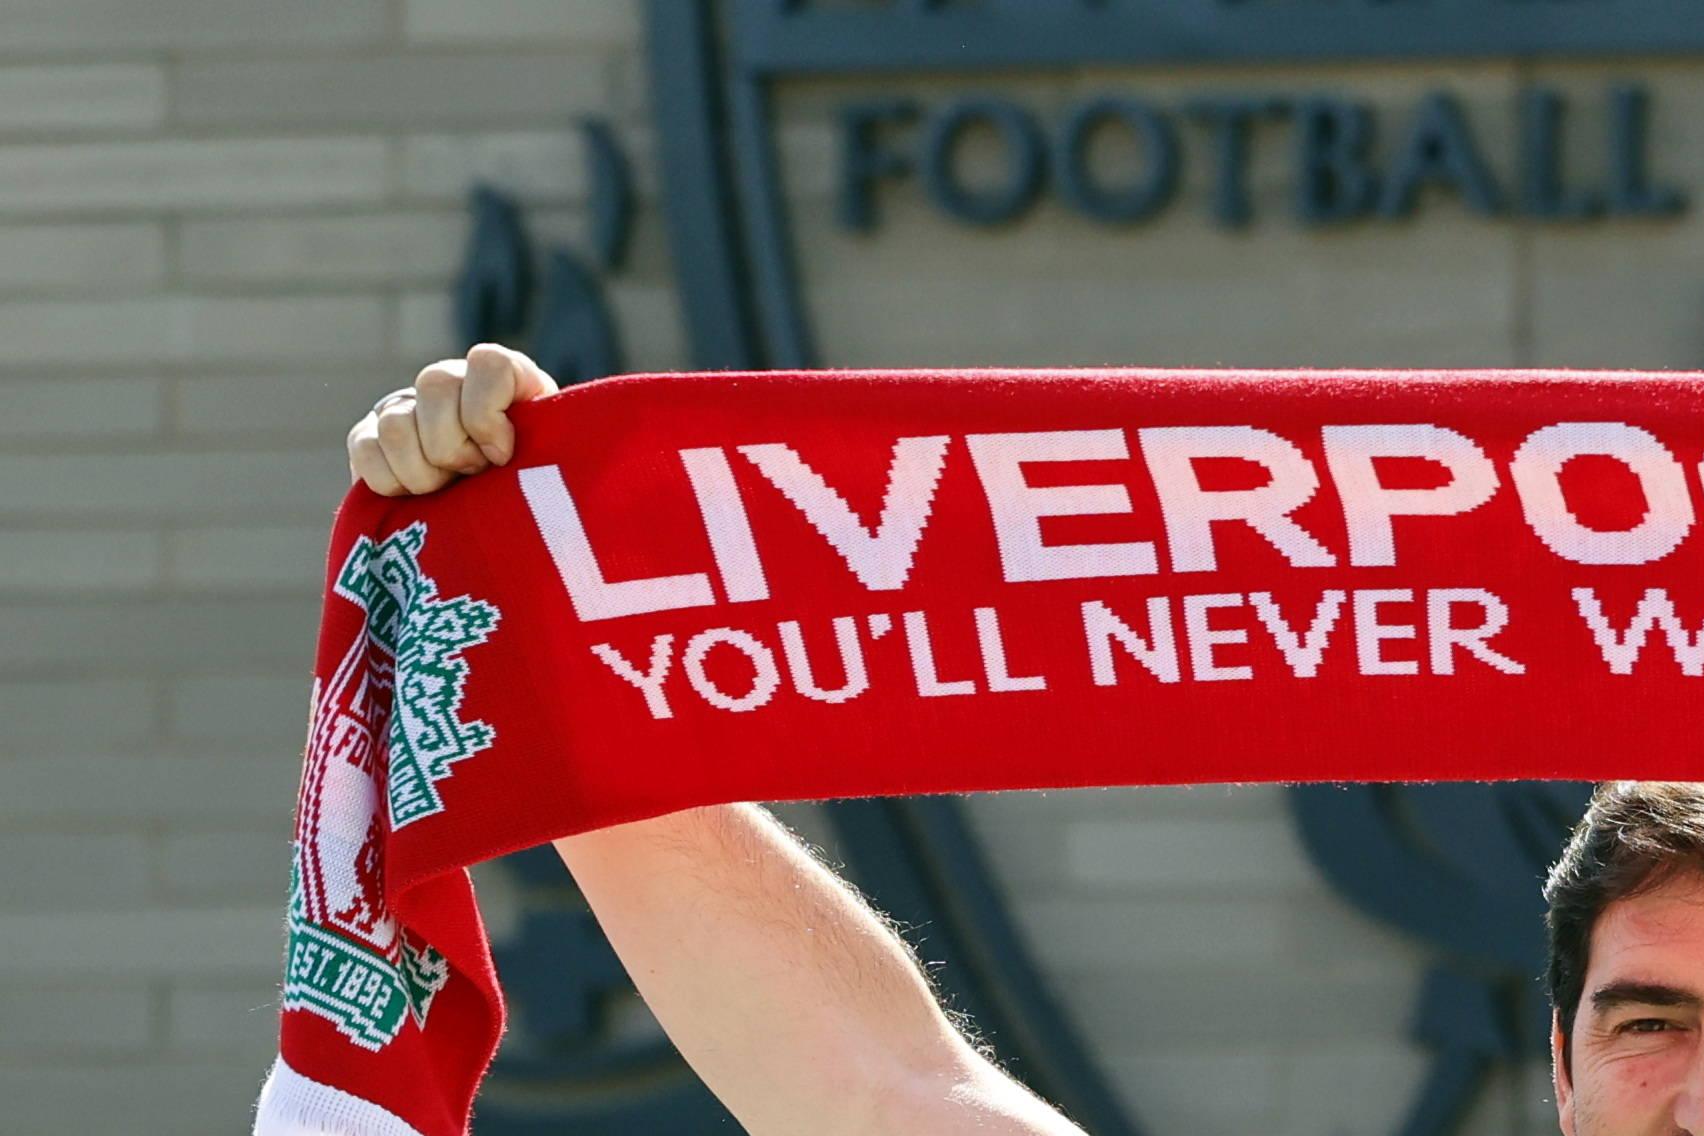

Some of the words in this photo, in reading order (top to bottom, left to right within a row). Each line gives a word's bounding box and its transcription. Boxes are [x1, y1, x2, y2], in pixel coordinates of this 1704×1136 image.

[838, 82, 1690, 228] FOOTBALL
[591, 608, 1046, 719] YOU'LL
[1082, 588, 1525, 685] NEVER
[332, 959, 392, 1019] 1892
